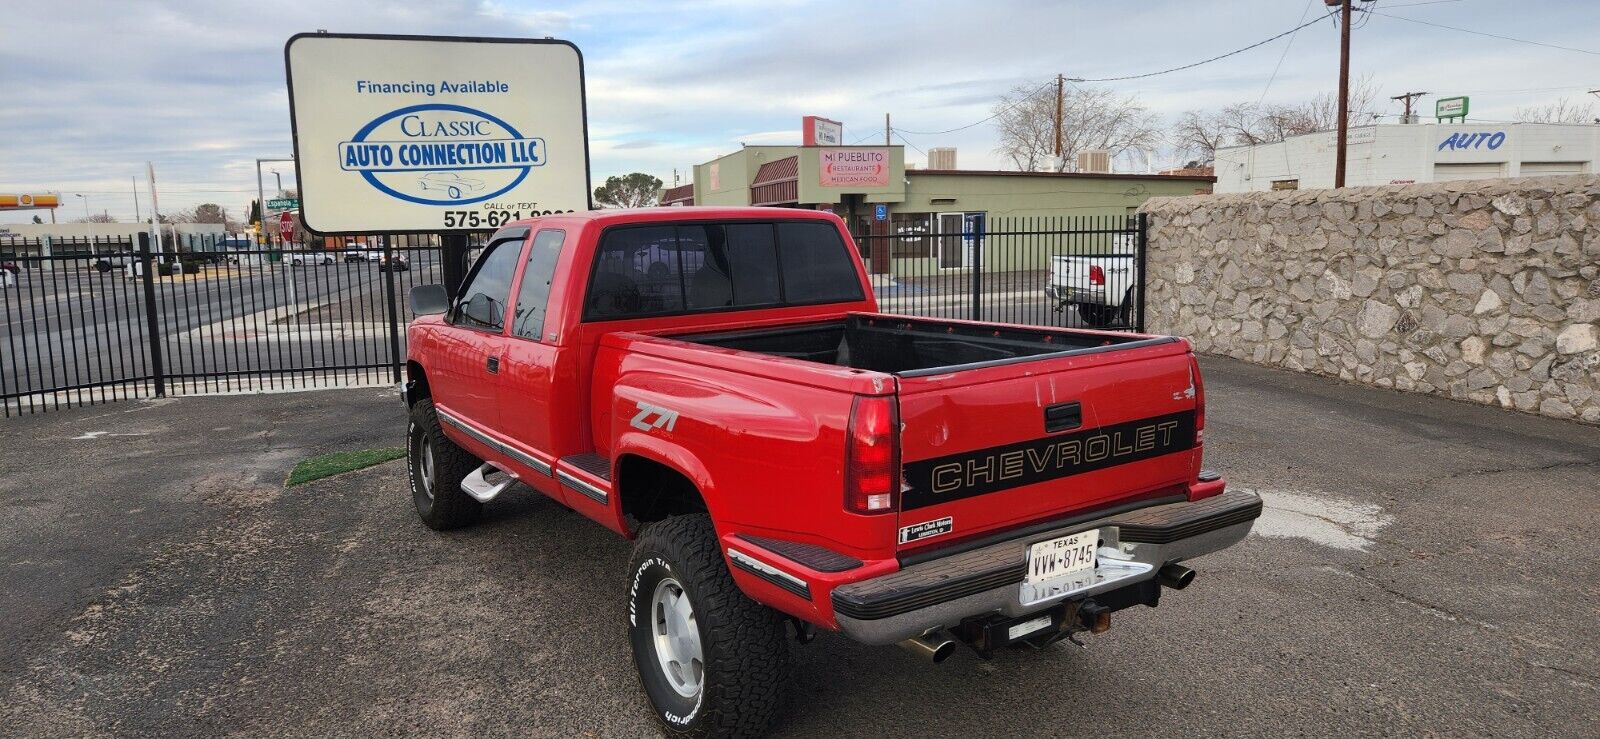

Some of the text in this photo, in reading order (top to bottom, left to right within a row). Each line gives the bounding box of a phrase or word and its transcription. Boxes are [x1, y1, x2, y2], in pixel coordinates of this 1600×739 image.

[357, 80, 509, 97] Financing Available
[400, 115, 492, 138] CLASSIC
[1438, 131, 1506, 151] AUTO
[345, 141, 539, 167] AUTO CONNECTION LLC
[838, 152, 883, 162] PUEBLITO
[483, 202, 504, 210] CALL
[516, 202, 538, 210] TEXT
[281, 220, 293, 232] STOP
[443, 210, 575, 228] 575-621
[630, 400, 680, 432] Z71
[931, 420, 1178, 494] CHEVROLET
[1053, 536, 1079, 549] TEXAS
[630, 557, 671, 628] All-Terrain T/A
